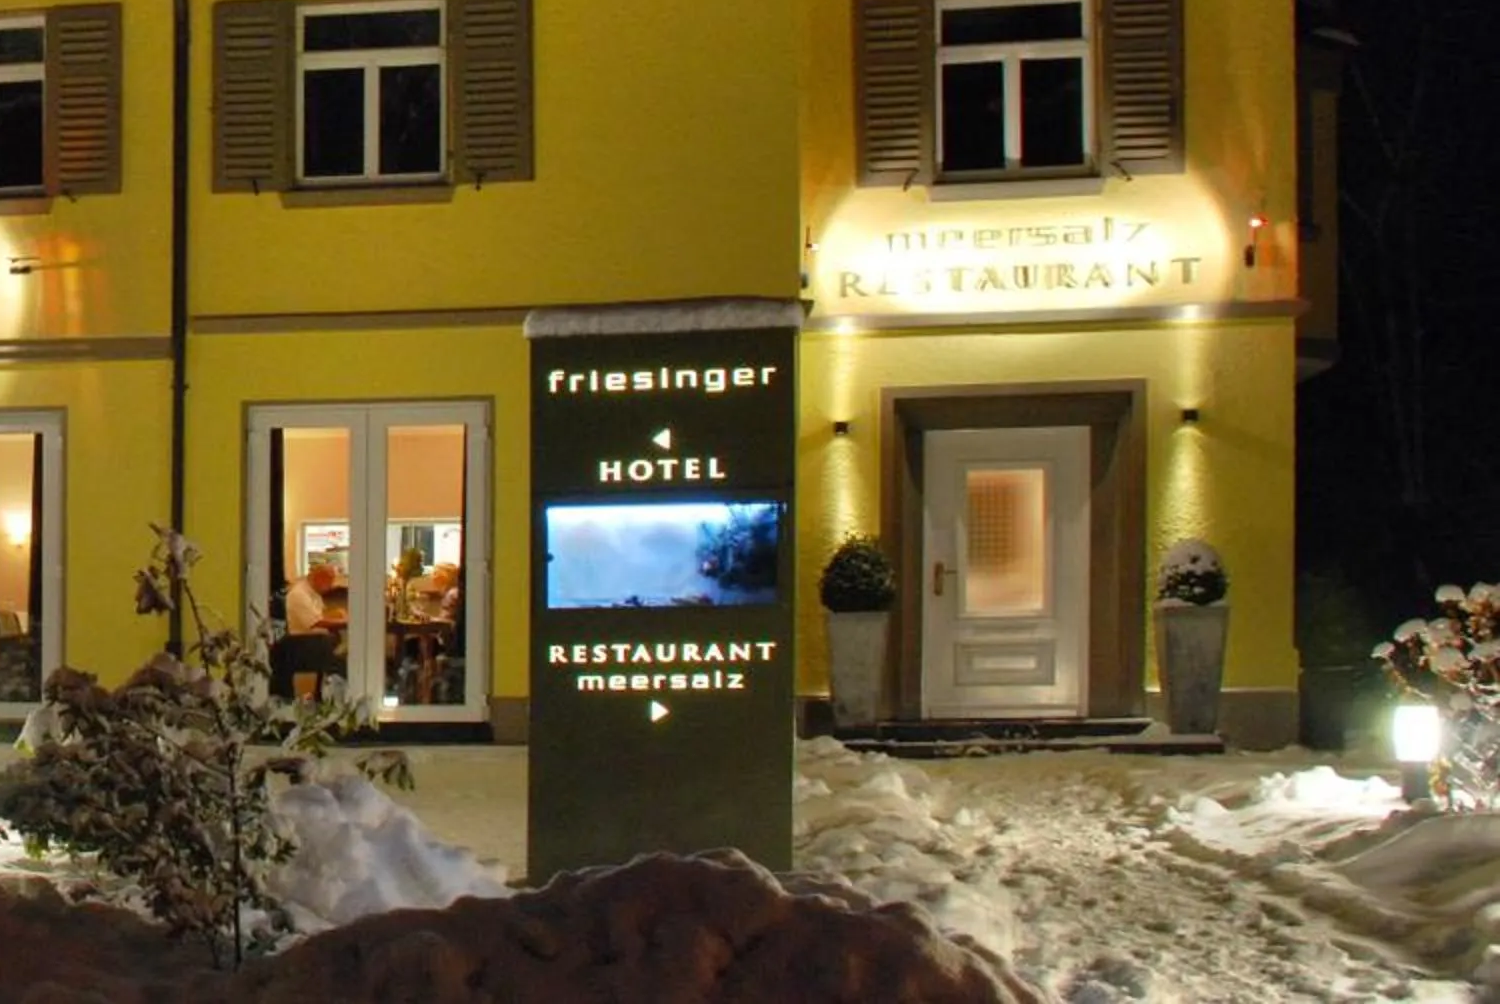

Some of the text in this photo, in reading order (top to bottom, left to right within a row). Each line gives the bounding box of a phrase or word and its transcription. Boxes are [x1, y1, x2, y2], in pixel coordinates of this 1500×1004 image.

[548, 366, 776, 393] friesinger
[600, 458, 726, 482] HOTEL
[549, 642, 777, 663] RESTAURANT
[577, 670, 745, 690] meersalz
